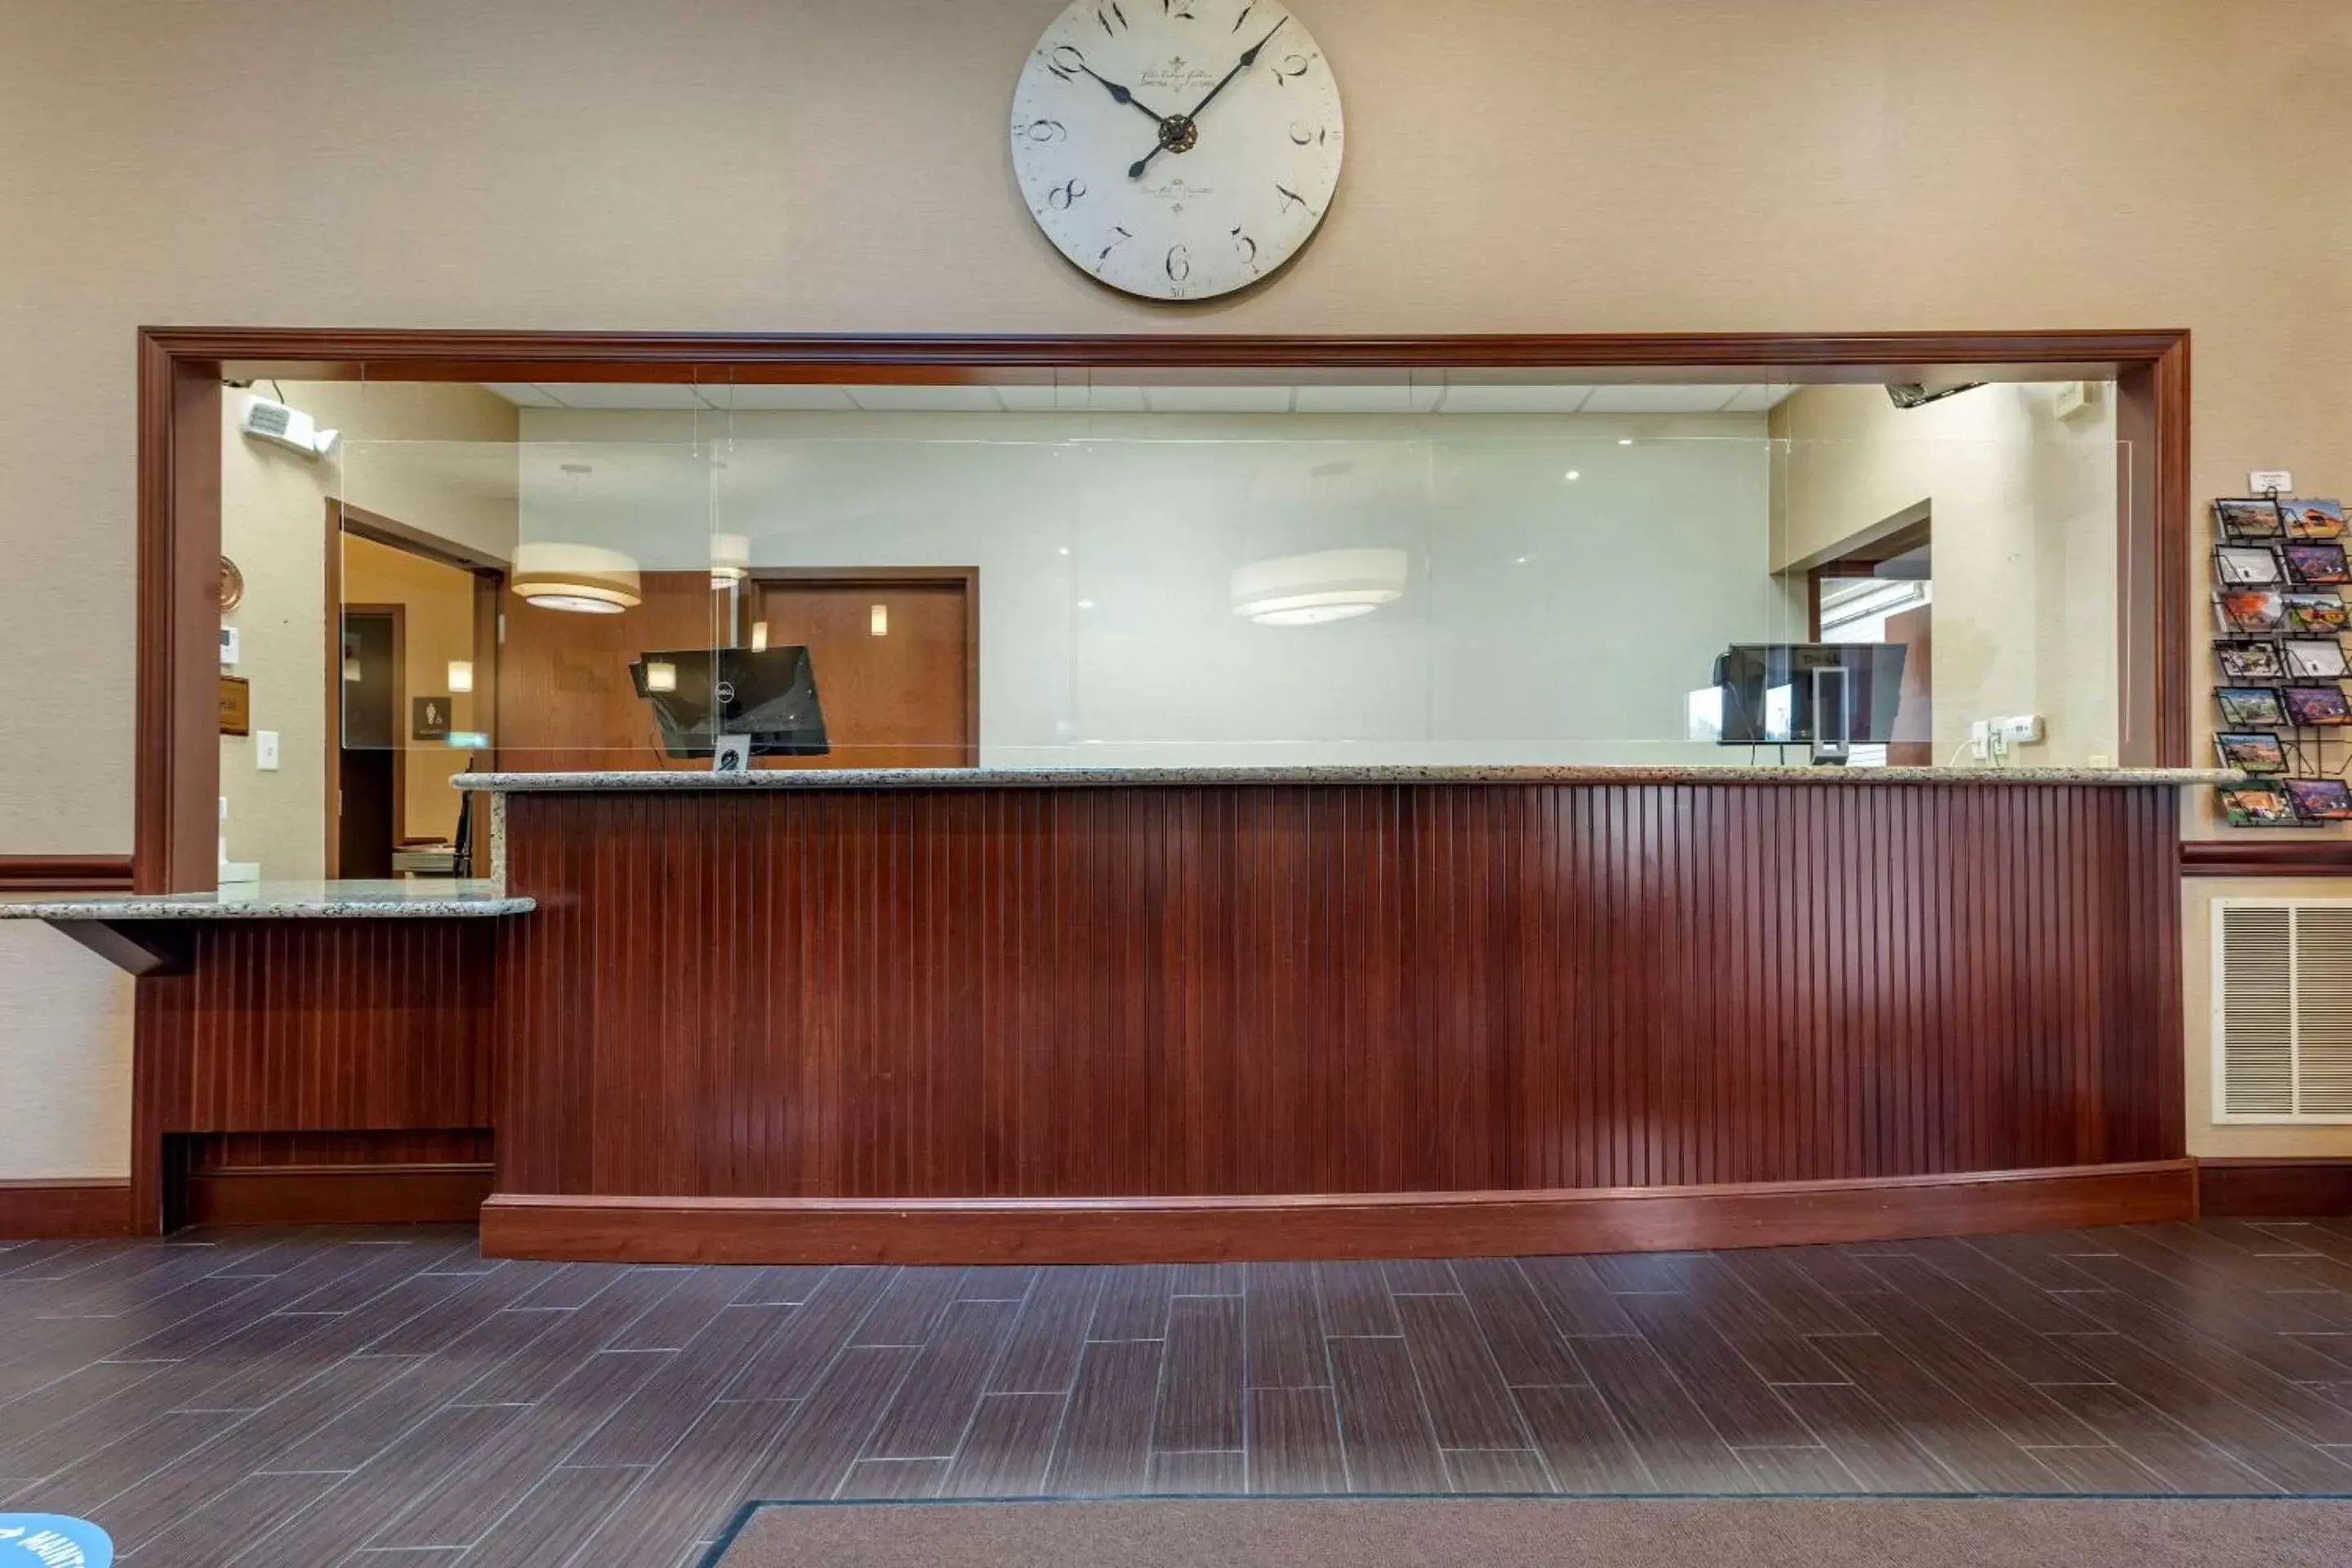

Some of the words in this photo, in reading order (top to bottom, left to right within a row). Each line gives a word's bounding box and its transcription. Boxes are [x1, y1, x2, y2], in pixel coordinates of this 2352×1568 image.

[1048, 46, 1085, 82] 10
[1271, 55, 1308, 87] 2
[1028, 120, 1067, 142] 9
[1289, 122, 1326, 147] 3
[1049, 178, 1087, 210] 8
[1276, 183, 1307, 214] 4
[1100, 226, 1134, 260] 7
[1231, 225, 1256, 264] 5
[1166, 244, 1189, 281] 6
